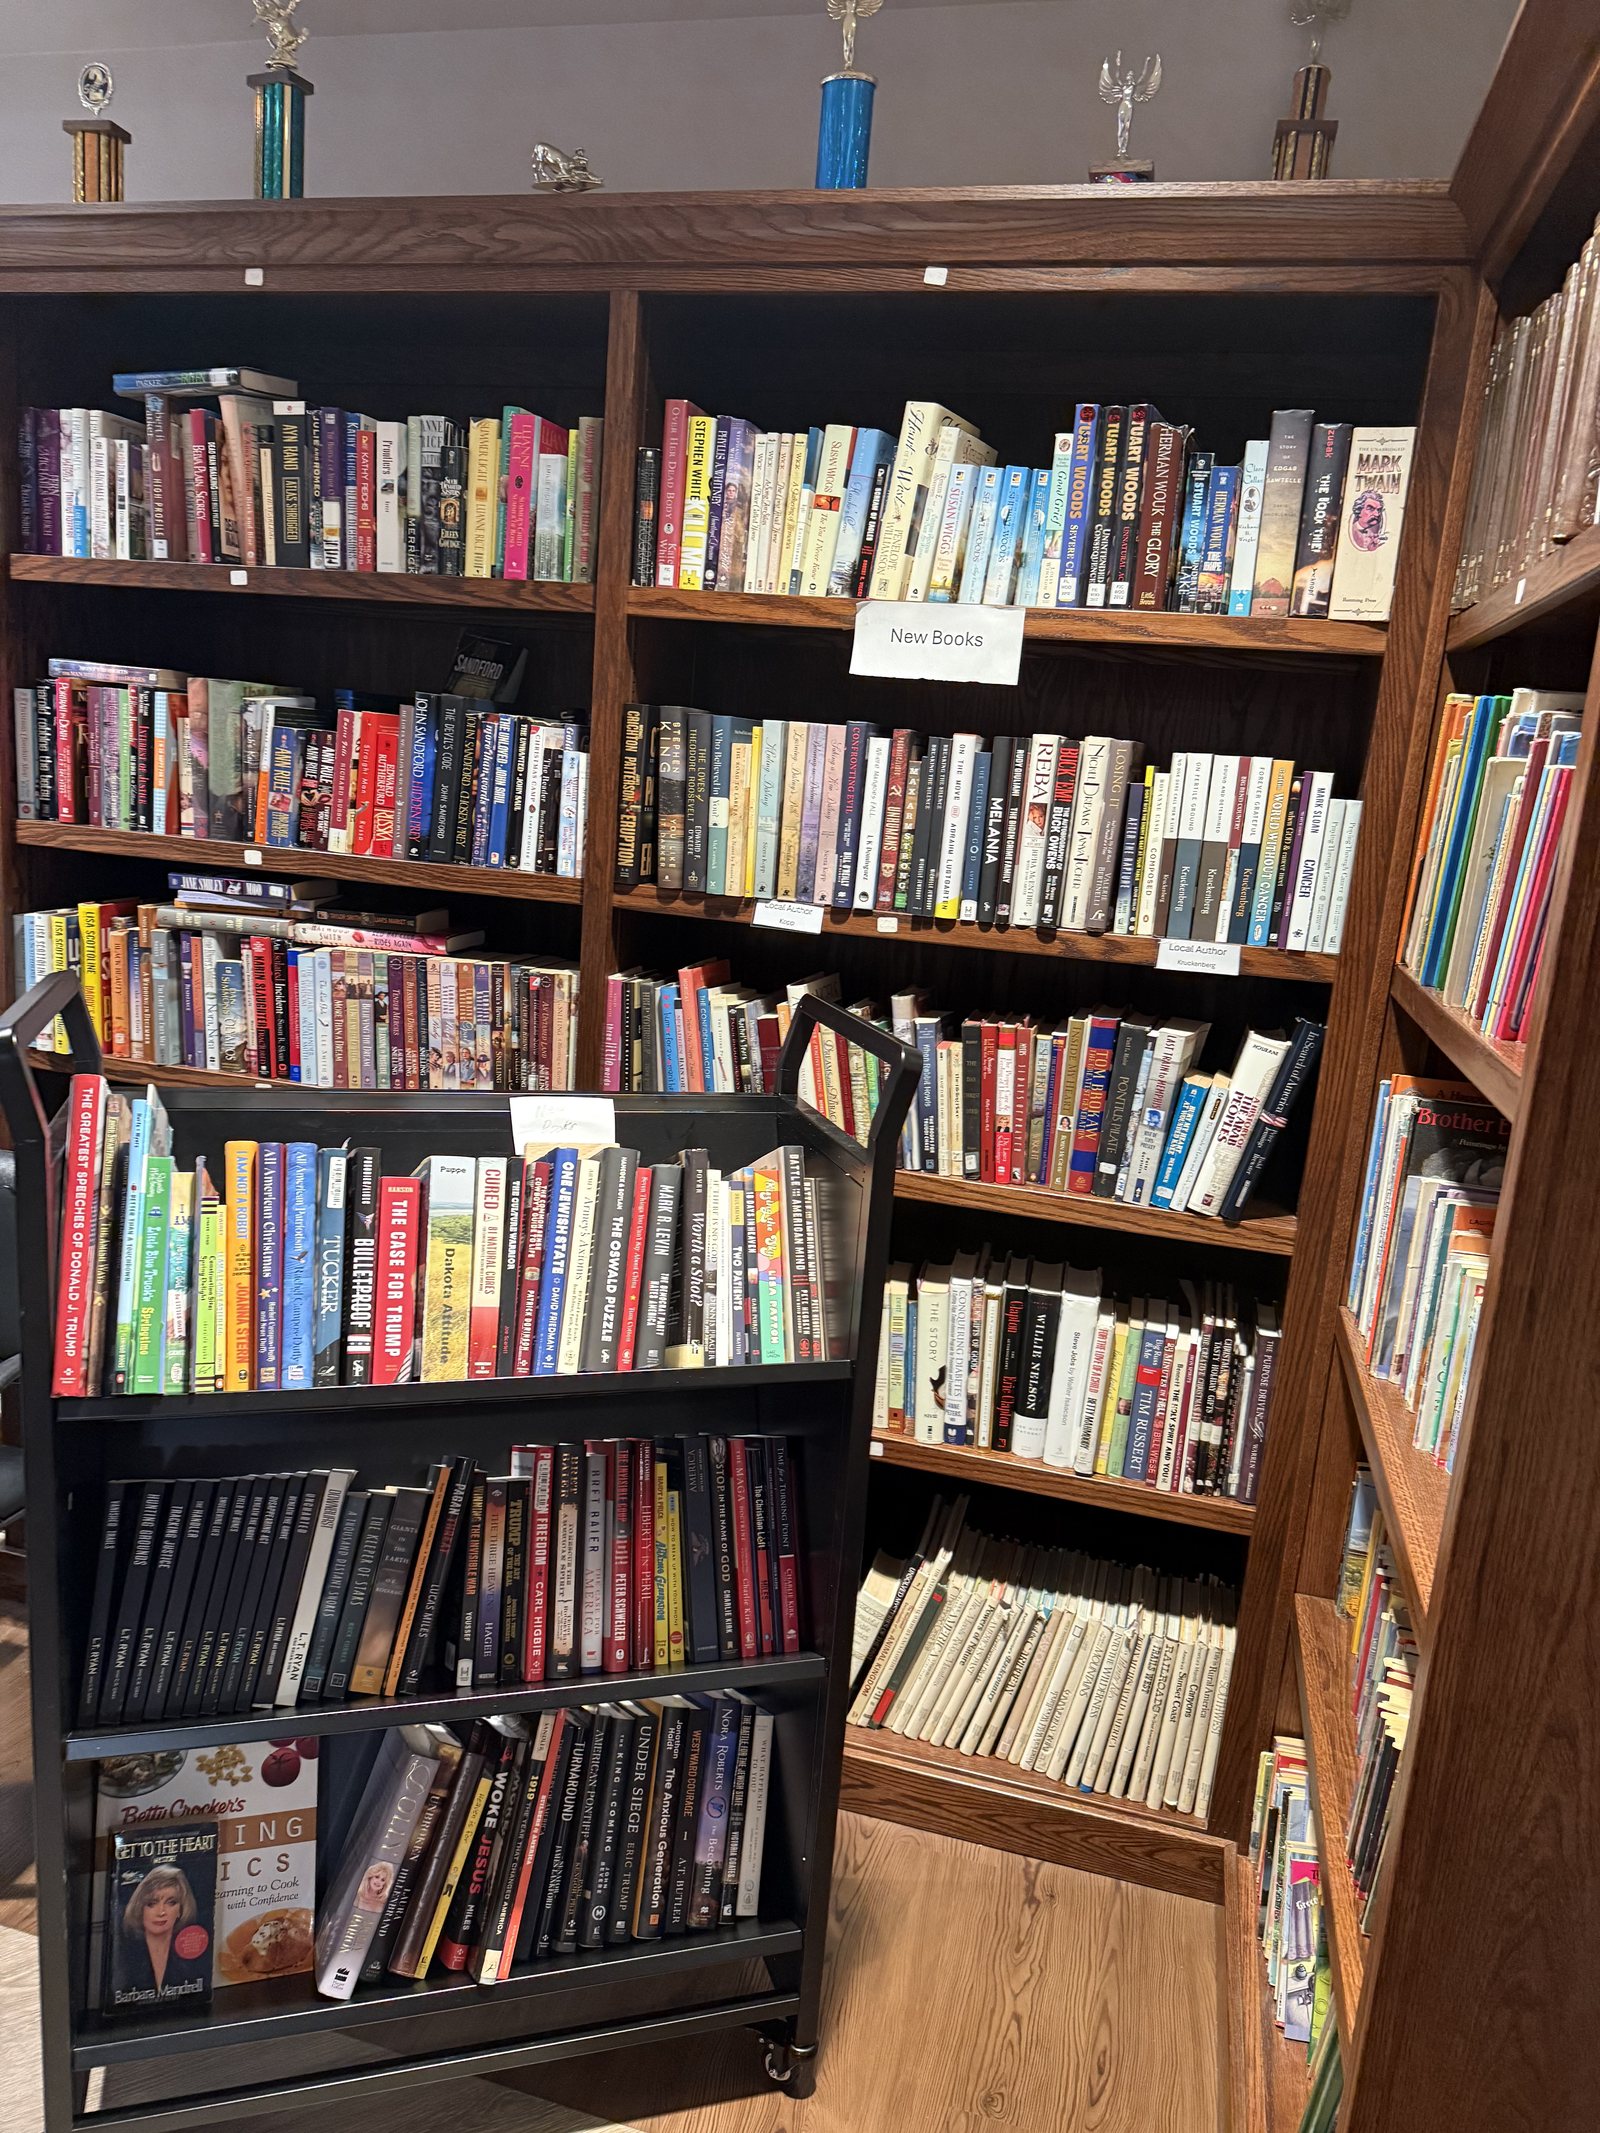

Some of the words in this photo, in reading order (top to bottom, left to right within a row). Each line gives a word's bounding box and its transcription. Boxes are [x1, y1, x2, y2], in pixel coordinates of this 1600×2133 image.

[282, 424, 299, 446] AYN
[693, 420, 706, 466] STEPHEN
[1127, 422, 1144, 462] TUART
[1156, 428, 1174, 478] HERMAN
[282, 449, 298, 471] RAND
[361, 452, 369, 480] KATHY
[1357, 454, 1402, 472] MARK
[284, 480, 298, 503] ATLAS
[360, 481, 369, 510] REICHS
[691, 469, 702, 501] WHITE
[1121, 466, 1138, 520] WOODS
[1151, 481, 1165, 515] WOUK
[1319, 474, 1331, 493] THE
[1354, 475, 1400, 494] TWAIN
[286, 505, 298, 541] SHRUGGED
[1152, 521, 1162, 535] THE
[1144, 535, 1160, 577] GLORY
[891, 628, 928, 644] New
[932, 630, 983, 646] Books
[454, 654, 504, 680] SANDFORD
[416, 698, 428, 721] JOHN
[625, 710, 640, 752] CRICHTON
[659, 722, 671, 773] KING
[672, 722, 681, 773] STEPHEN
[714, 729, 724, 746] Who
[411, 724, 427, 778] SANDFORD
[1058, 748, 1079, 778] BUCK
[385, 764, 394, 796] EDWARD
[1032, 743, 1053, 799] REBA
[1111, 749, 1127, 793] LOSING
[1110, 797, 1119, 810] IT
[1272, 792, 1285, 833] WORLD
[618, 814, 636, 867] ERUPTION
[884, 807, 900, 851] UNHUMANS
[985, 797, 1004, 864] MELANIA
[1265, 837, 1278, 880] WITHOUT
[1174, 866, 1190, 912] Kruckenberg
[1200, 868, 1217, 914] Kruckenberg
[1298, 859, 1315, 898] CANCER
[1256, 882, 1270, 922] CANCER
[85, 912, 94, 930] LISA
[86, 931, 96, 974] SCOTTOLINE
[1169, 943, 1194, 953] Local
[1195, 946, 1227, 956] Author
[1177, 959, 1216, 970] Kruckenberg
[1095, 1049, 1111, 1076] TOM
[80, 1087, 93, 1108] THE
[1085, 1077, 1106, 1141] BROKAW
[1417, 1106, 1495, 1134] Brother
[77, 1112, 92, 1168] GREATEST
[264, 1149, 276, 1164] All
[236, 1156, 248, 1174] AM
[562, 1162, 574, 1186] ONE
[73, 1172, 86, 1229] SPEECHES
[236, 1176, 248, 1194] NOT
[263, 1167, 276, 1219] American
[484, 1169, 501, 1209] CURED
[657, 1184, 675, 1217] MARK
[391, 1200, 408, 1225] THE
[558, 1190, 572, 1232] JEWISH
[610, 1217, 624, 1238] THE
[657, 1218, 669, 1228] R.
[72, 1232, 82, 1249] OF
[262, 1222, 275, 1277] Christmas
[389, 1230, 406, 1266] CASE
[653, 1228, 671, 1255] LEVIN
[691, 1211, 705, 1252] Worth
[442, 1248, 456, 1298] Dakota
[551, 1235, 568, 1275] STATE
[606, 1240, 621, 1294] OSWALD
[69, 1253, 82, 1300] DONALD
[350, 1238, 374, 1328] BULLETPROOF
[388, 1272, 404, 1300] FOR
[68, 1301, 78, 1312] J.
[236, 1283, 251, 1322] JOANNA
[601, 1296, 615, 1342] PUZZLE
[930, 1302, 939, 1321] THE
[63, 1316, 78, 1357] TRUMP
[236, 1325, 250, 1364] STERN
[384, 1306, 402, 1356] TRUMP
[929, 1326, 939, 1362] STORY
[1031, 1314, 1047, 1361] WILLIE
[1025, 1362, 1043, 1411] NELSON
[1142, 1391, 1155, 1416] TIM
[1129, 1418, 1152, 1474] RUSSERT
[716, 1464, 726, 1492] STOP
[446, 1483, 466, 1516] PAGAN
[718, 1505, 726, 1520] THE
[535, 1516, 548, 1566] FREEDOM
[617, 1573, 628, 1599] PETER
[720, 1555, 731, 1583] GOD
[535, 1581, 544, 1609] CARL
[722, 1589, 733, 1616] CHARLIE
[532, 1614, 542, 1656] HIGBIE
[614, 1600, 626, 1642] SCHWEIZER
[290, 1654, 306, 1681] RYAN
[877, 1633, 896, 1668] ANIMAL
[719, 1708, 732, 1742] NORA
[636, 1726, 652, 1782] UNDER
[714, 1745, 728, 1791] ROBERTS
[561, 1741, 586, 1822] TURNAROUND
[664, 1768, 676, 1790] The
[484, 1771, 508, 1829] WOKE
[627, 1787, 644, 1834] SIEGE
[659, 1792, 674, 1839] Anxious
[115, 1844, 139, 1860] GET
[141, 1841, 154, 1857] TO
[156, 1839, 178, 1856] THE
[180, 1834, 217, 1851] HEART
[469, 1834, 492, 1894] JESUS
[651, 1840, 668, 1909] Generation
[701, 1837, 718, 1894] Becoming
[227, 1897, 246, 1910] with
[249, 1892, 299, 1907] Confidence
[258, 1884, 268, 1893] to
[270, 1878, 300, 1890] Cook
